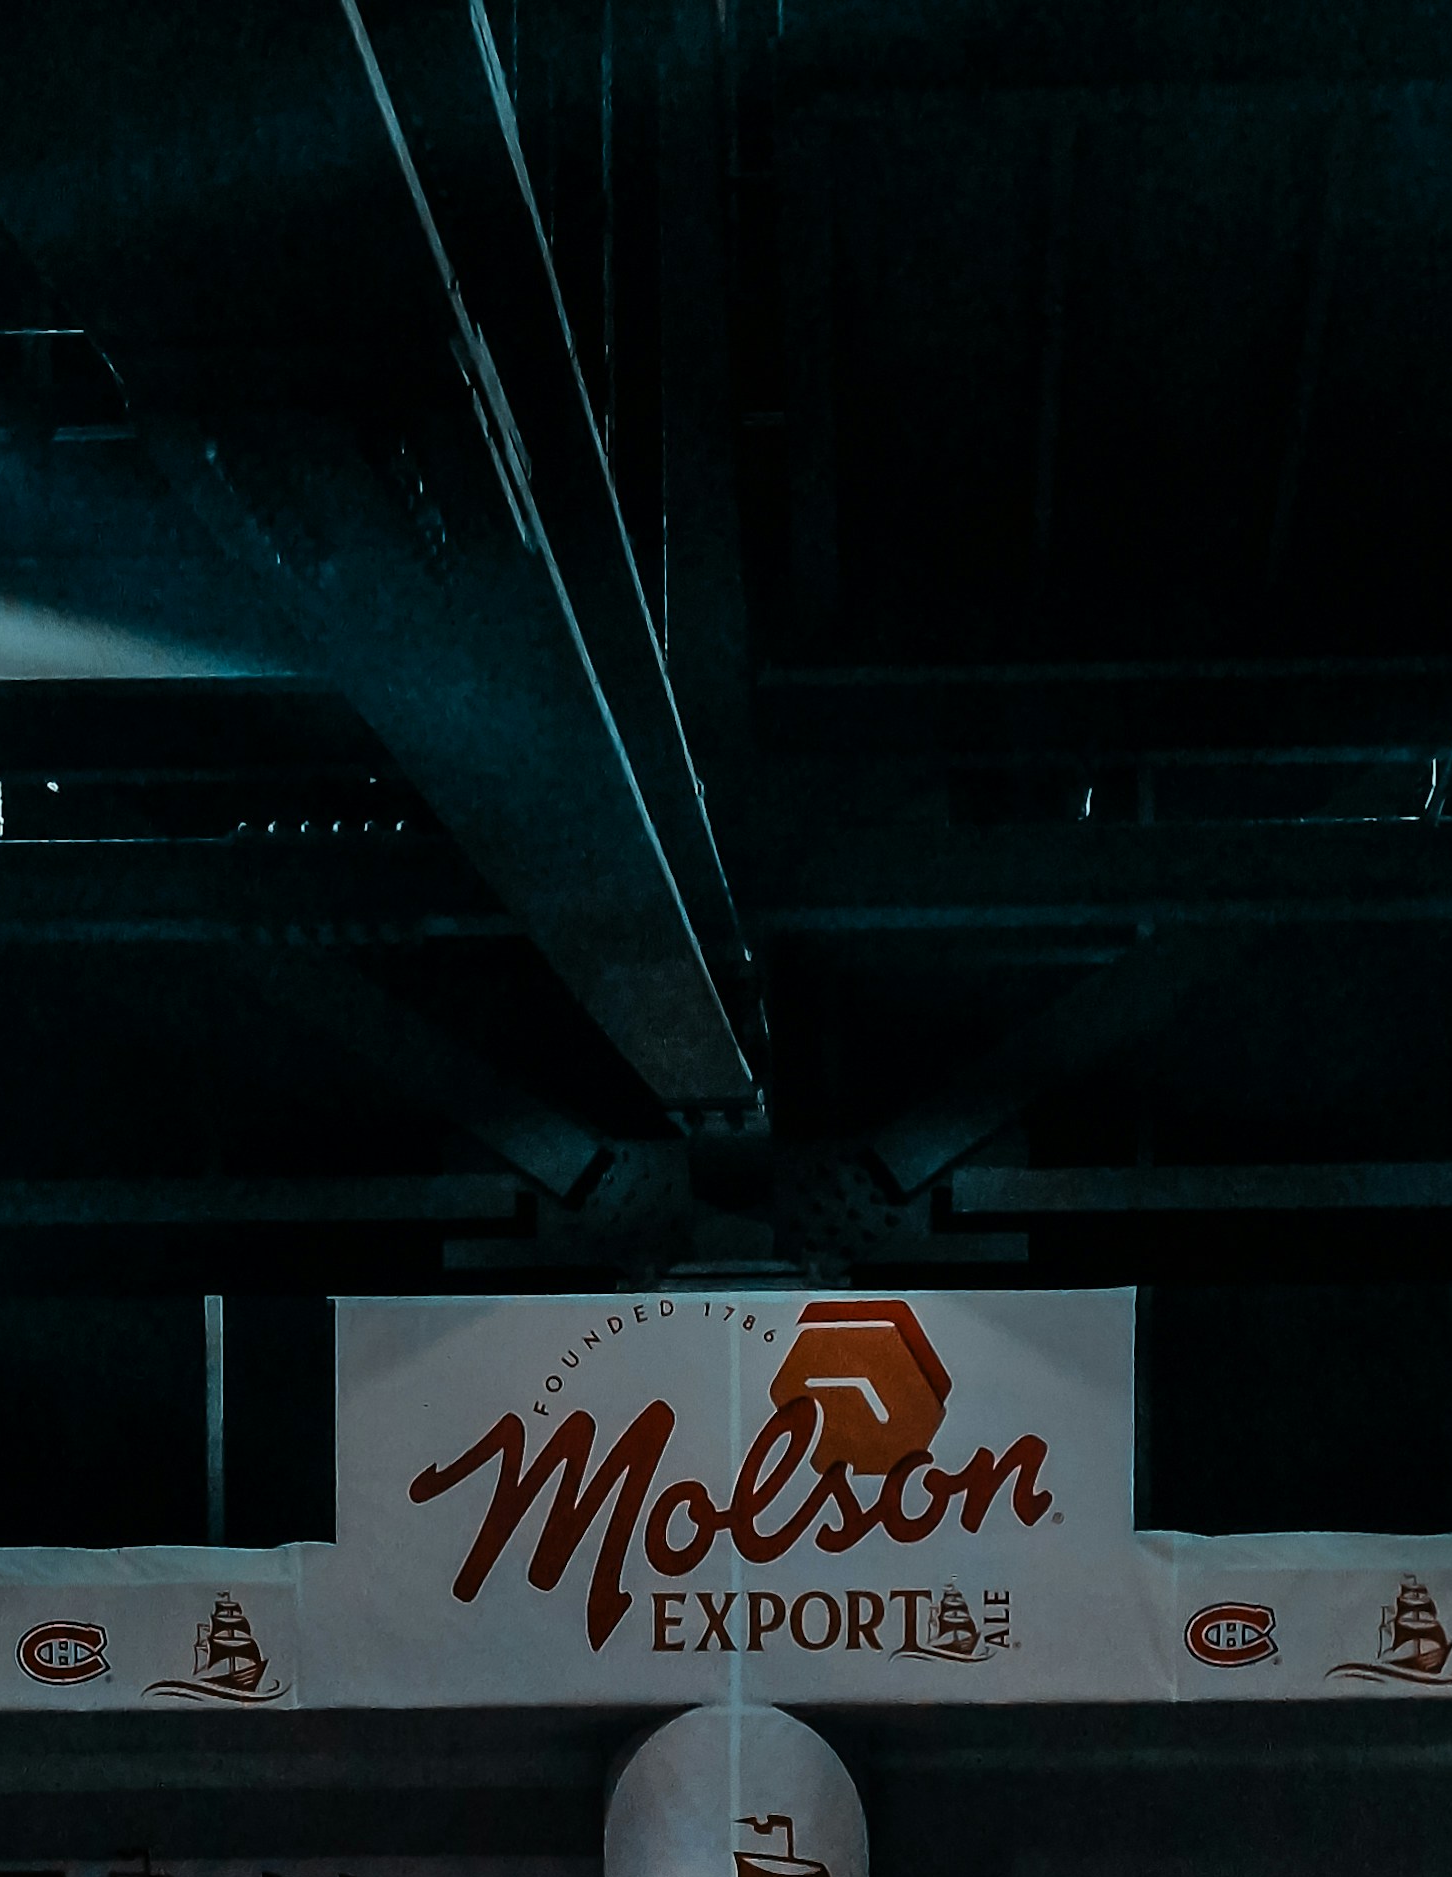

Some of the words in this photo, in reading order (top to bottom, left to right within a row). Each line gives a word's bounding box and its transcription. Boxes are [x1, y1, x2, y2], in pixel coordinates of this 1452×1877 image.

[534, 1299, 675, 1415] FOUNDED
[703, 1301, 777, 1344] 1786
[410, 1399, 1053, 1652] Molson
[652, 1589, 927, 1656] EXPORT
[984, 1590, 1011, 1649] ALE
